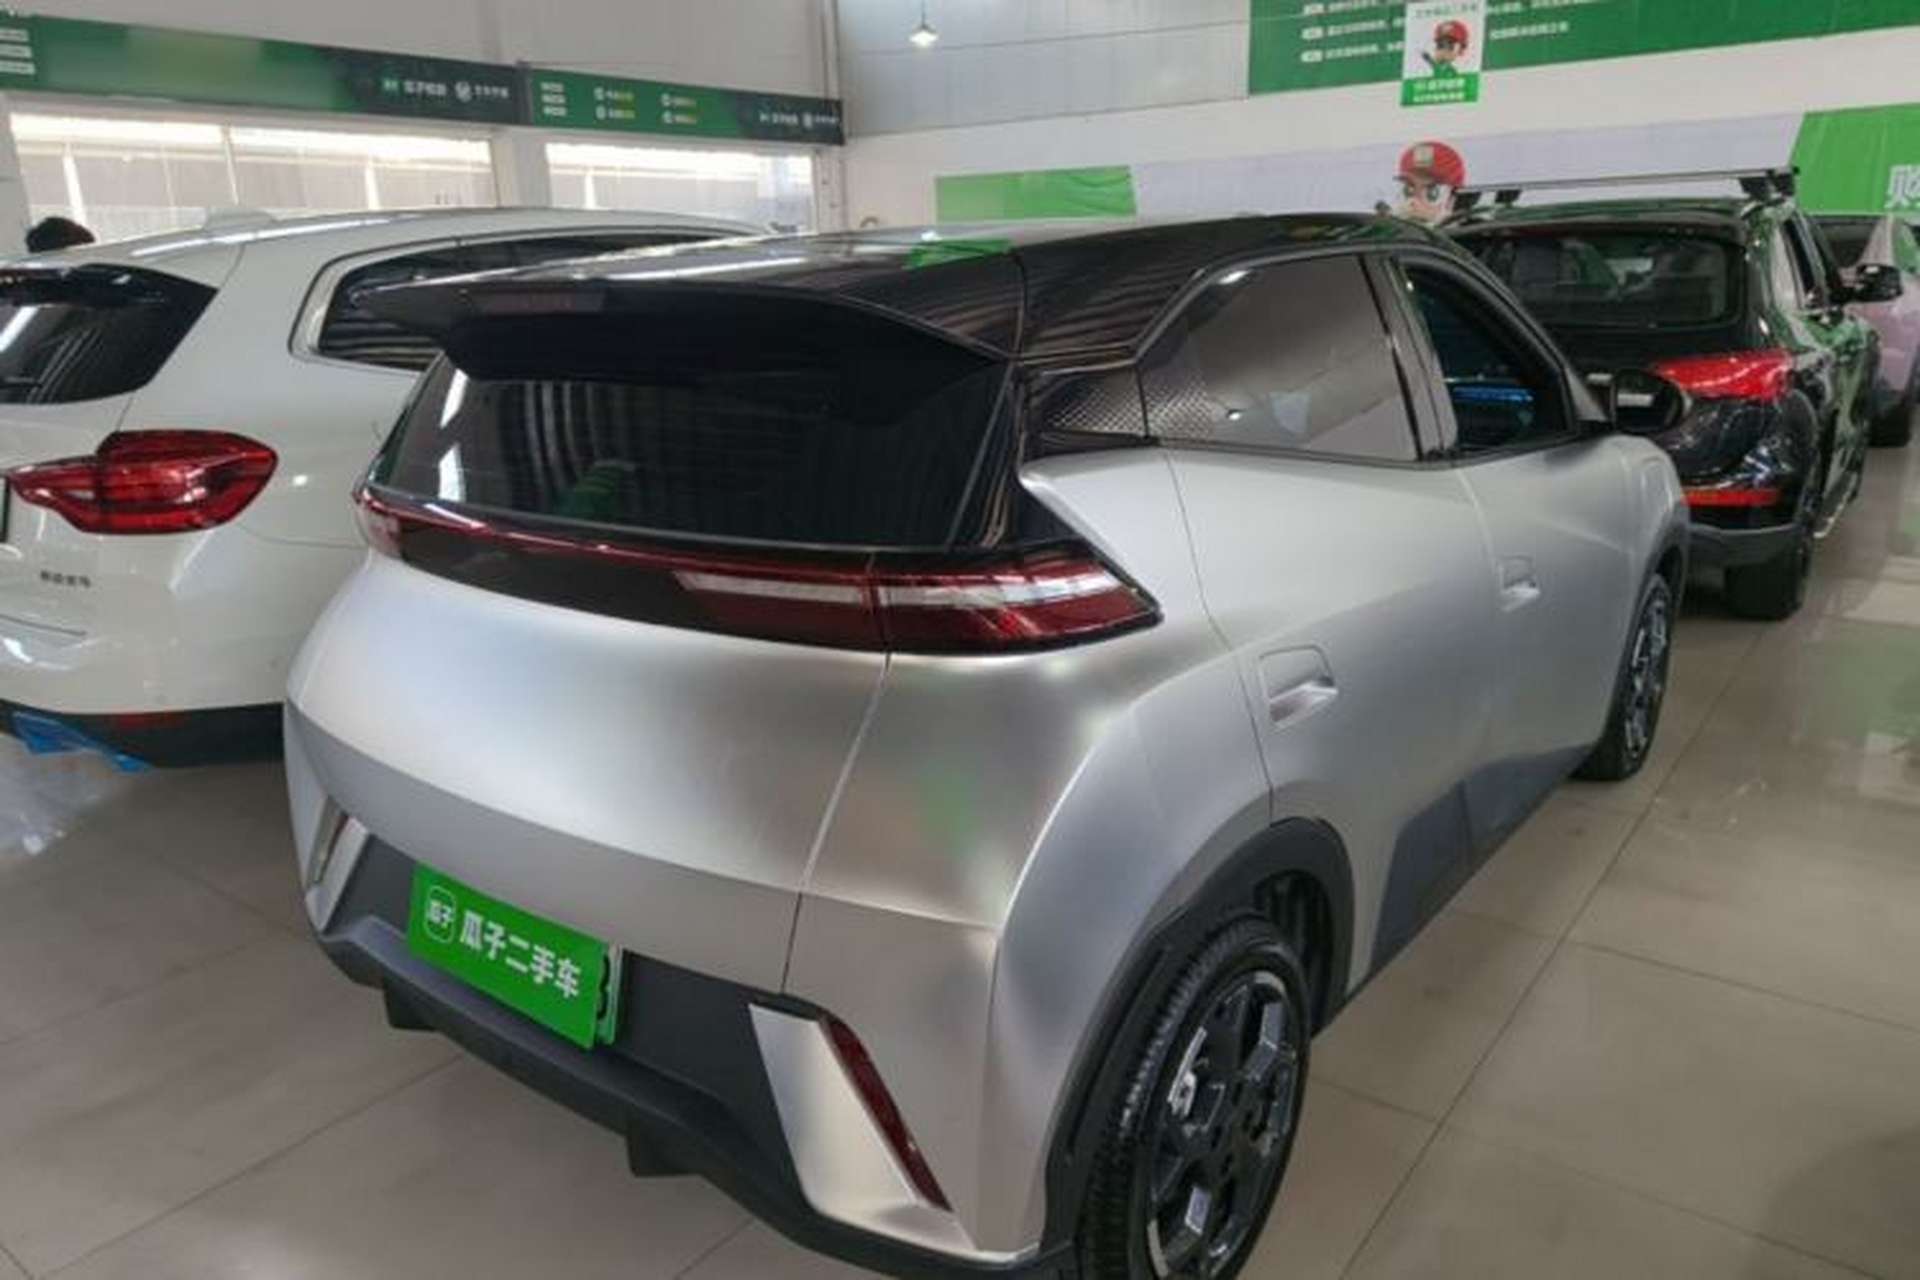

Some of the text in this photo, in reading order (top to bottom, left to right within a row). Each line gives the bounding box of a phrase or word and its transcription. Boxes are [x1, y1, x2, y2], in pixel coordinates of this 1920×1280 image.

[460, 910, 580, 998] 瓜子二手车
